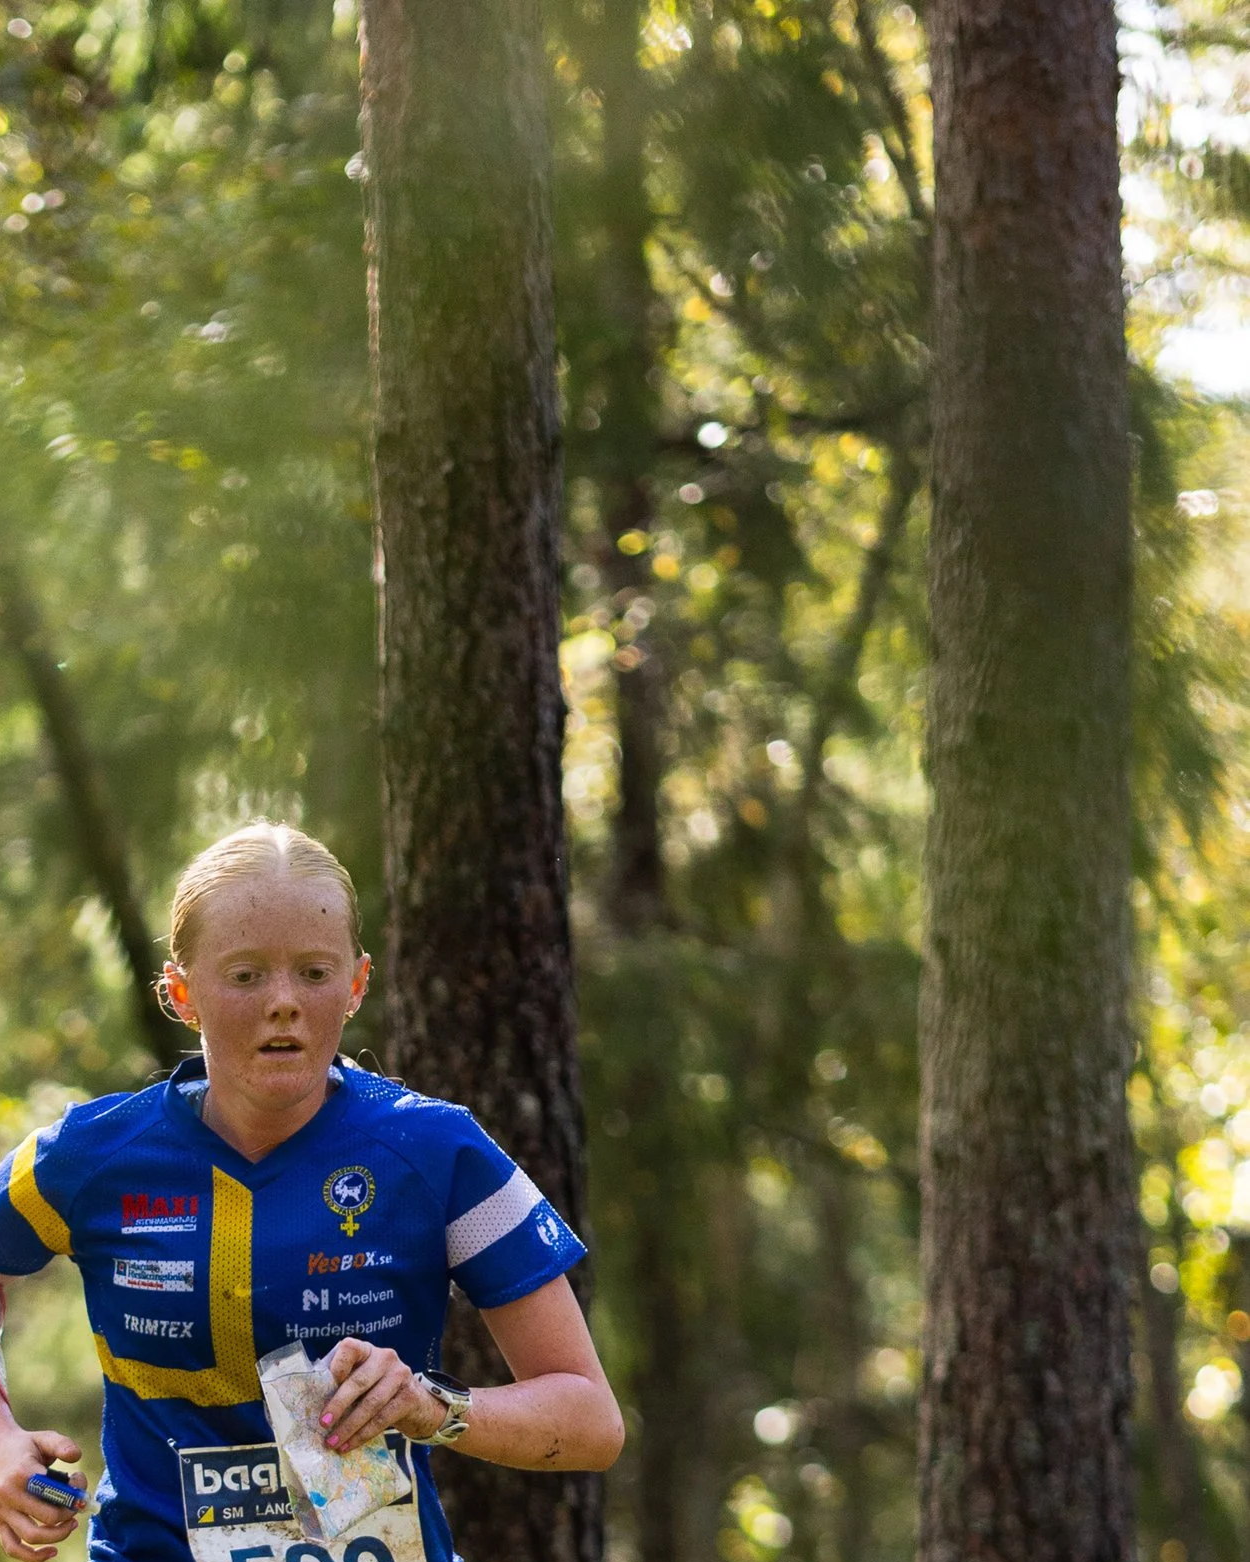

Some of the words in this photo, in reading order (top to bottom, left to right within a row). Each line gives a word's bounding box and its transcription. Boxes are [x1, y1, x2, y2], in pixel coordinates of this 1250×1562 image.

[338, 1289, 394, 1306] Moelven
[124, 1313, 194, 1338] TRIMTEX
[286, 1313, 403, 1339] Handelsbanken
[193, 1463, 286, 1495] bag
[222, 1506, 244, 1519] SM
